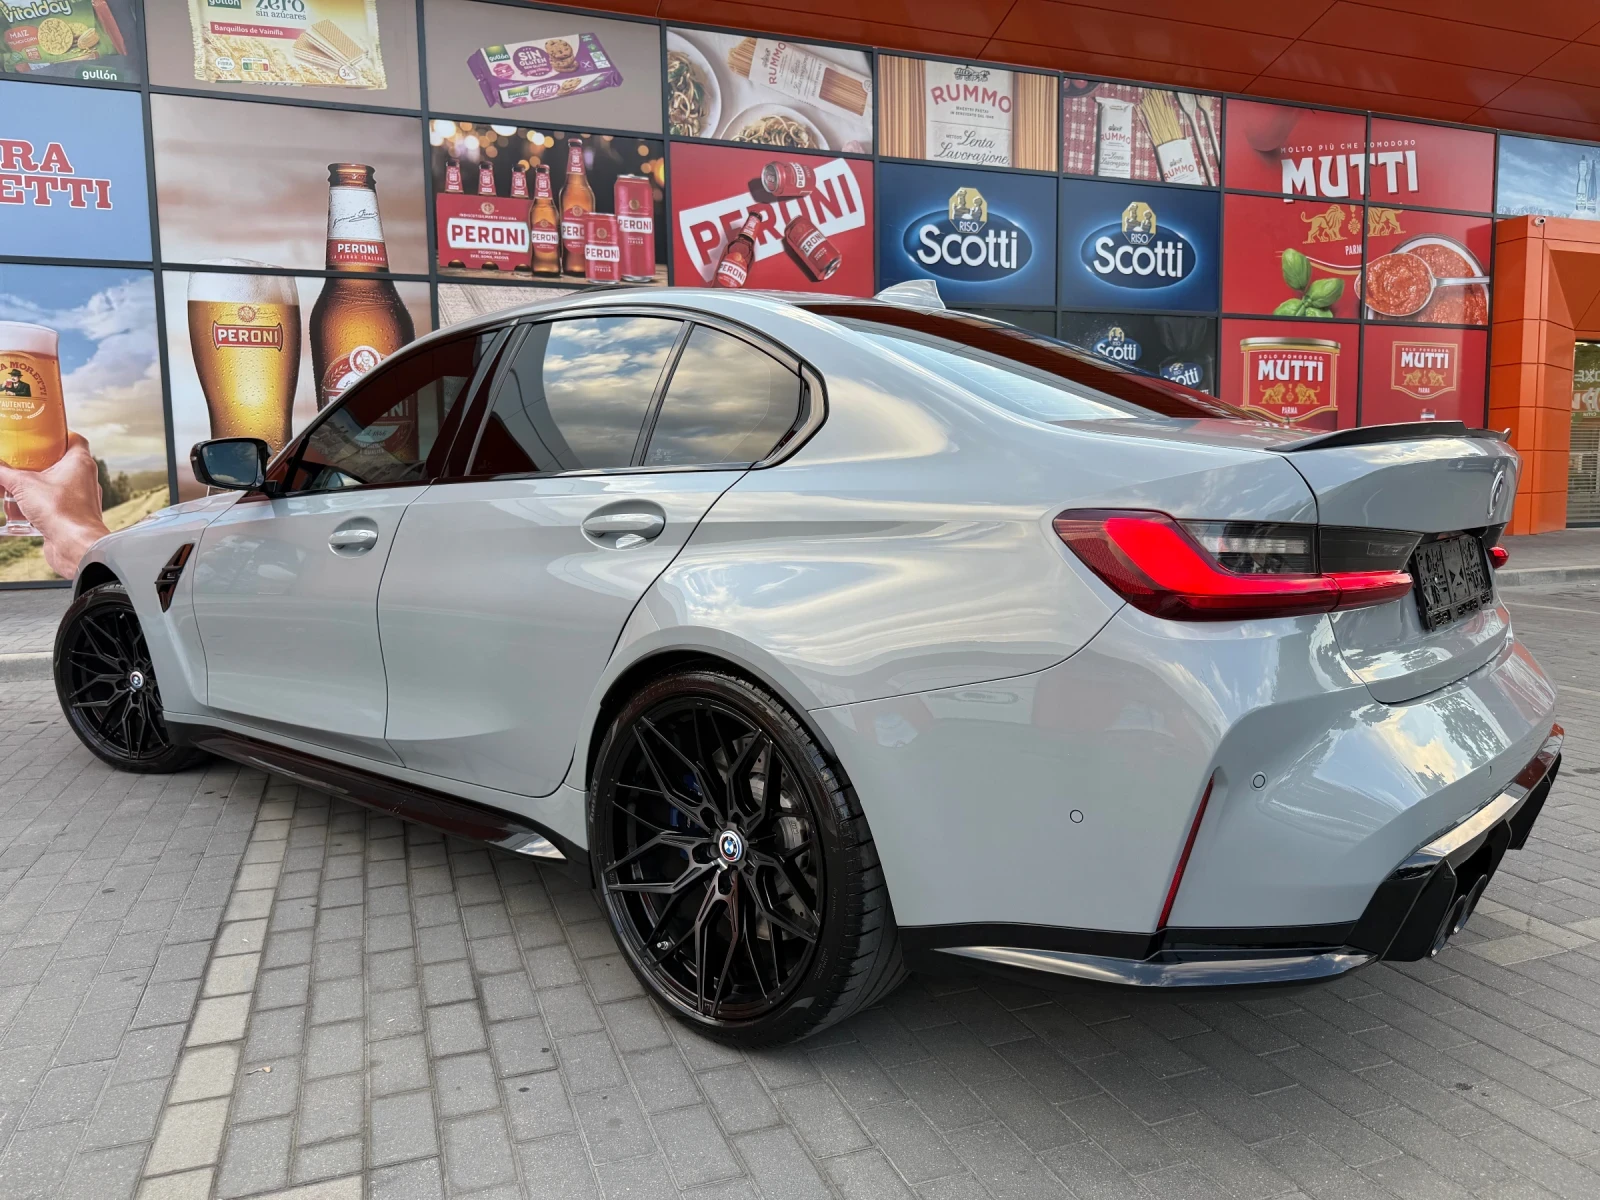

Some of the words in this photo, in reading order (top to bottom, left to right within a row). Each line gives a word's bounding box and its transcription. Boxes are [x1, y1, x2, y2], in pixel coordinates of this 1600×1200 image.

[256, 8, 269, 17] sin
[271, 10, 307, 20] azúcares
[214, 24, 249, 33] Barquillos
[259, 28, 284, 36] Vainilla
[768, 42, 787, 85] RUMMO
[82, 70, 118, 81] gullón
[931, 84, 1012, 113] RUMMO
[957, 130, 996, 149] Lenta
[1280, 145, 1313, 154] MOLTO
[1318, 142, 1335, 151] PIÙ
[1340, 142, 1358, 150] CHE
[1364, 139, 1416, 148] OMODORO
[1163, 164, 1195, 181] RUMMO
[1281, 150, 1418, 203] MUTTI
[619, 218, 652, 231] PERONI
[958, 220, 979, 233] RISO
[452, 224, 526, 246] PERONI
[532, 233, 558, 242] PERONI
[1131, 233, 1149, 244] RISO
[338, 243, 379, 254] PERONI
[586, 247, 620, 259] PERONI
[916, 224, 1018, 269] Scotti
[1093, 236, 1183, 278] Scotti
[217, 329, 278, 343] PERONI
[1097, 343, 1136, 360] Scotti
[1401, 352, 1449, 369] MUTTI
[10, 361, 48, 396] MORETTI
[1258, 360, 1323, 382] MUTTI
[1281, 406, 1298, 414] PARMA
